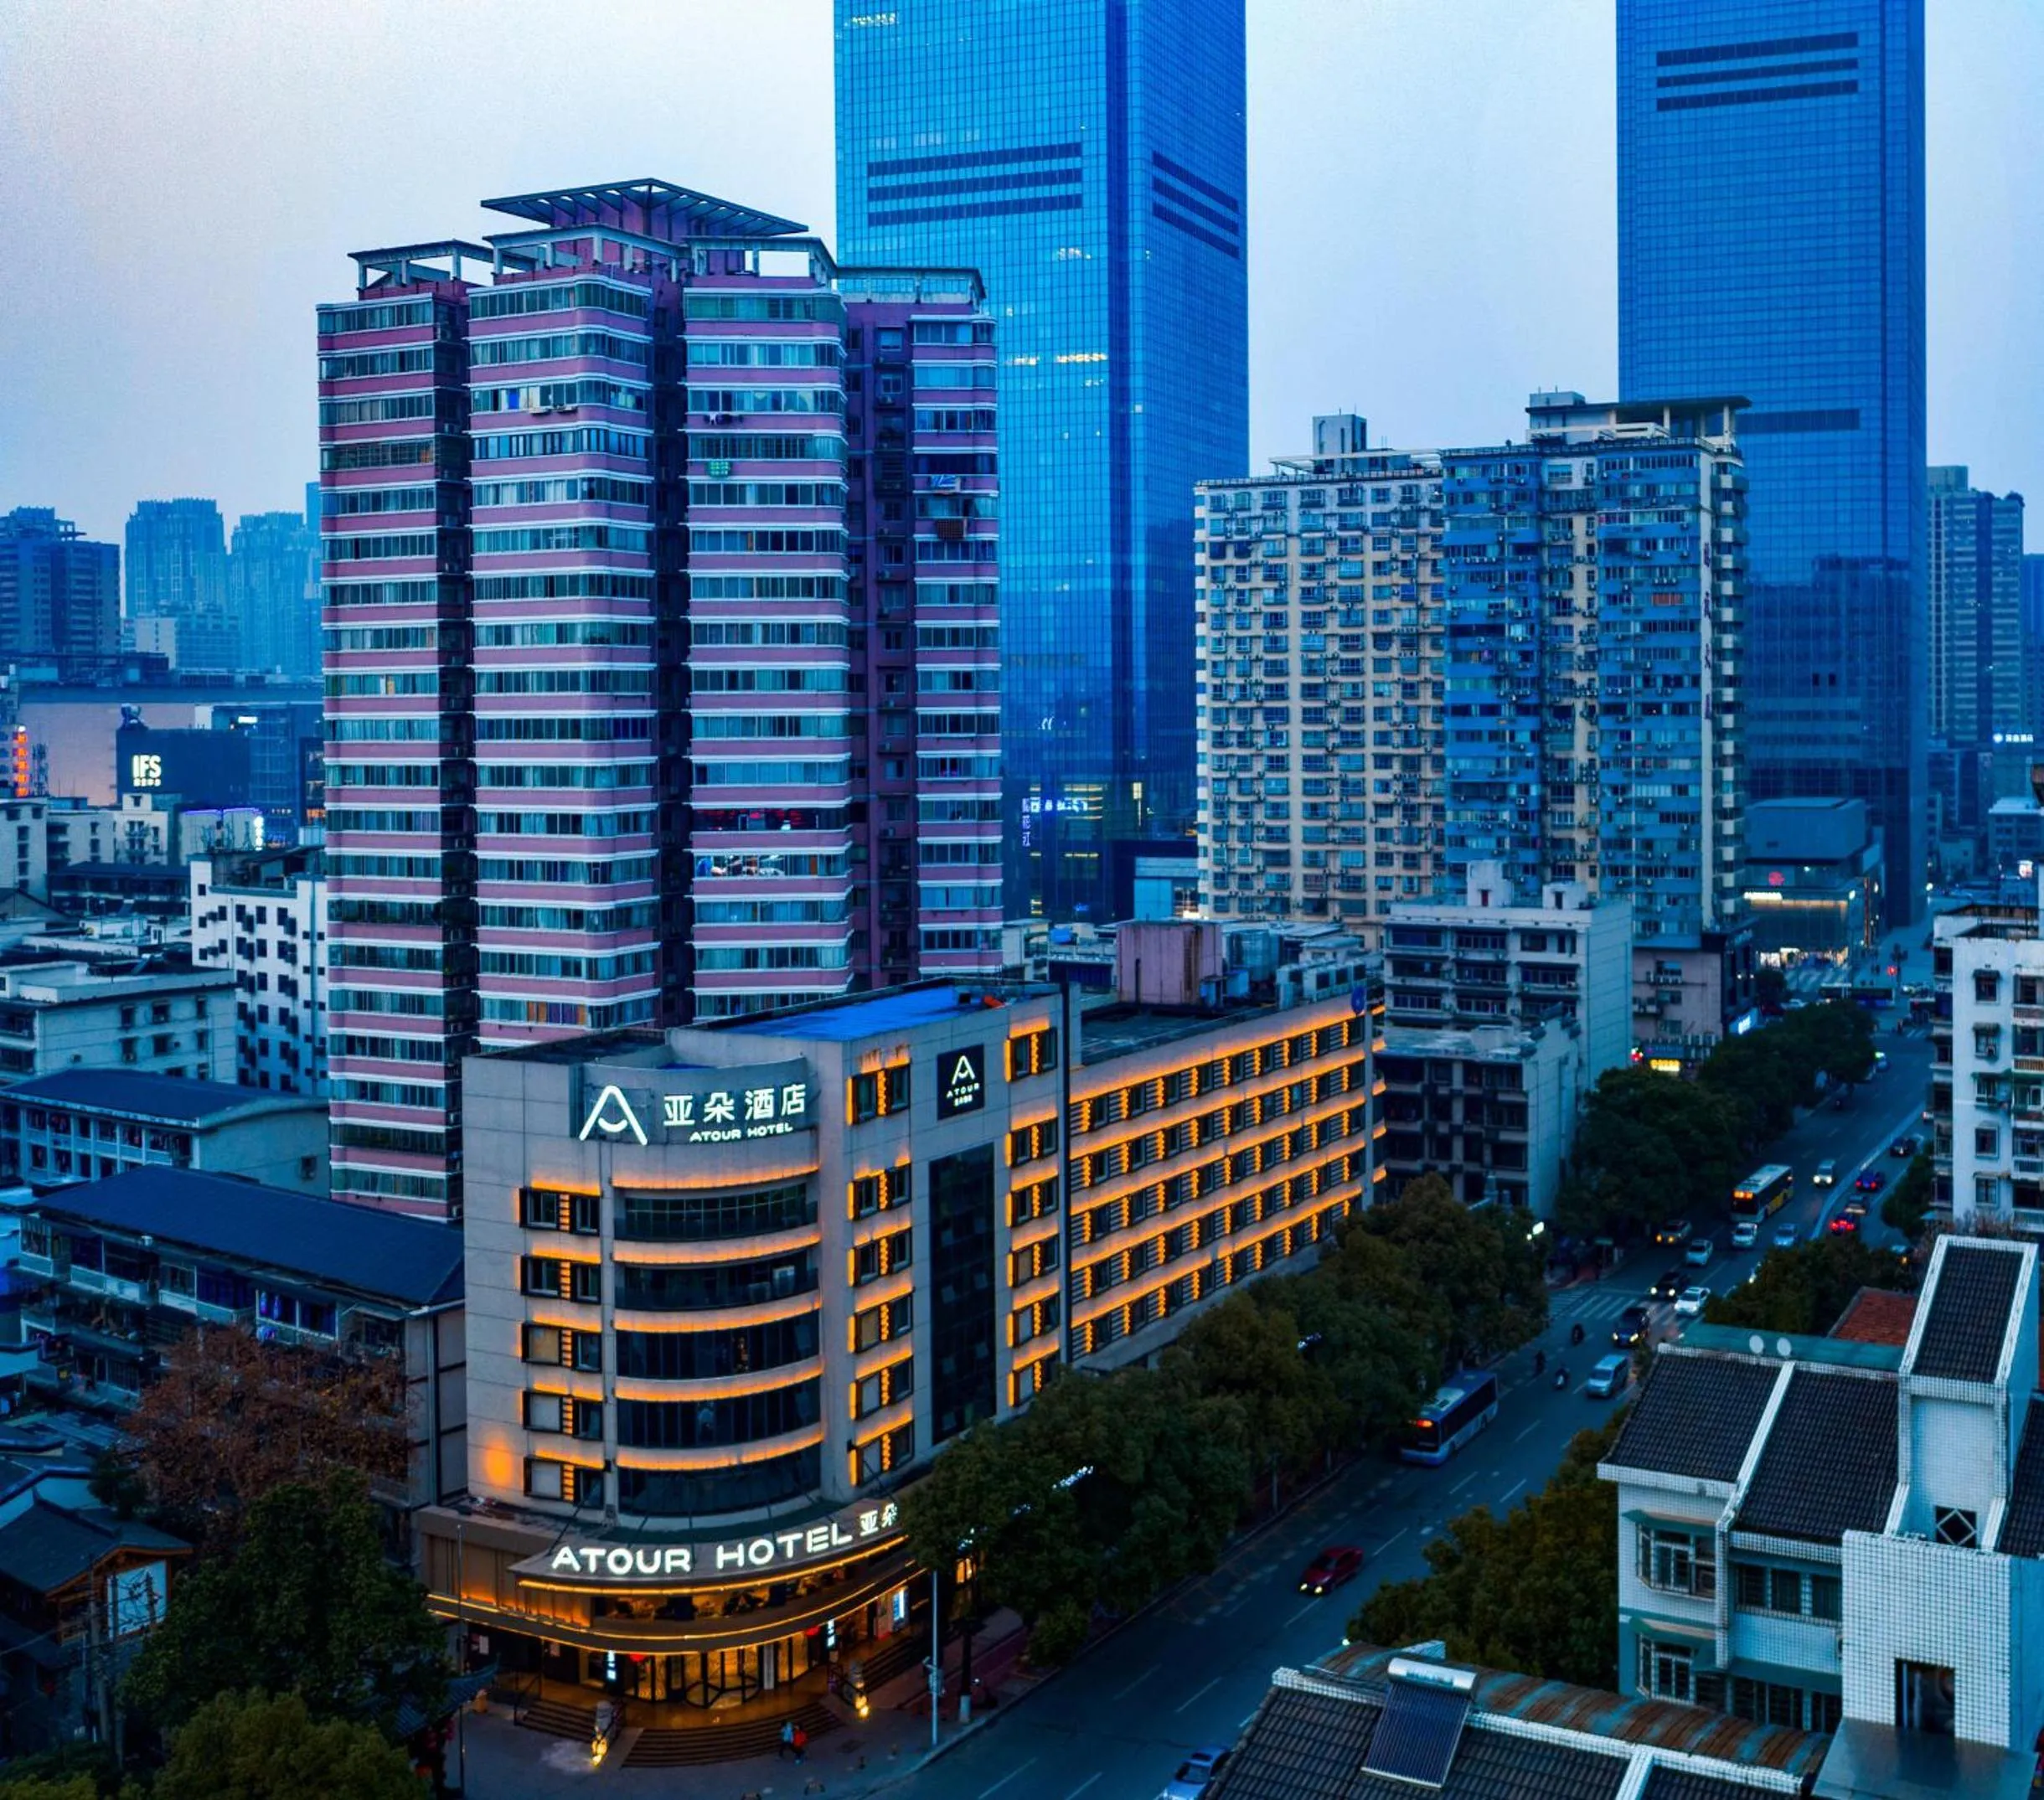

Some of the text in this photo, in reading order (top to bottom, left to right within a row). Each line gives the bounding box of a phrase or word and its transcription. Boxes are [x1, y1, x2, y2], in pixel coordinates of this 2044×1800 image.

[132, 755, 162, 778] IFS
[946, 1082, 979, 1099] ATOUR
[663, 1084, 806, 1126] 亚朵酒店
[689, 1122, 793, 1142] ATOUR HOTEL
[551, 1522, 854, 1575] ATOUR HOTEL
